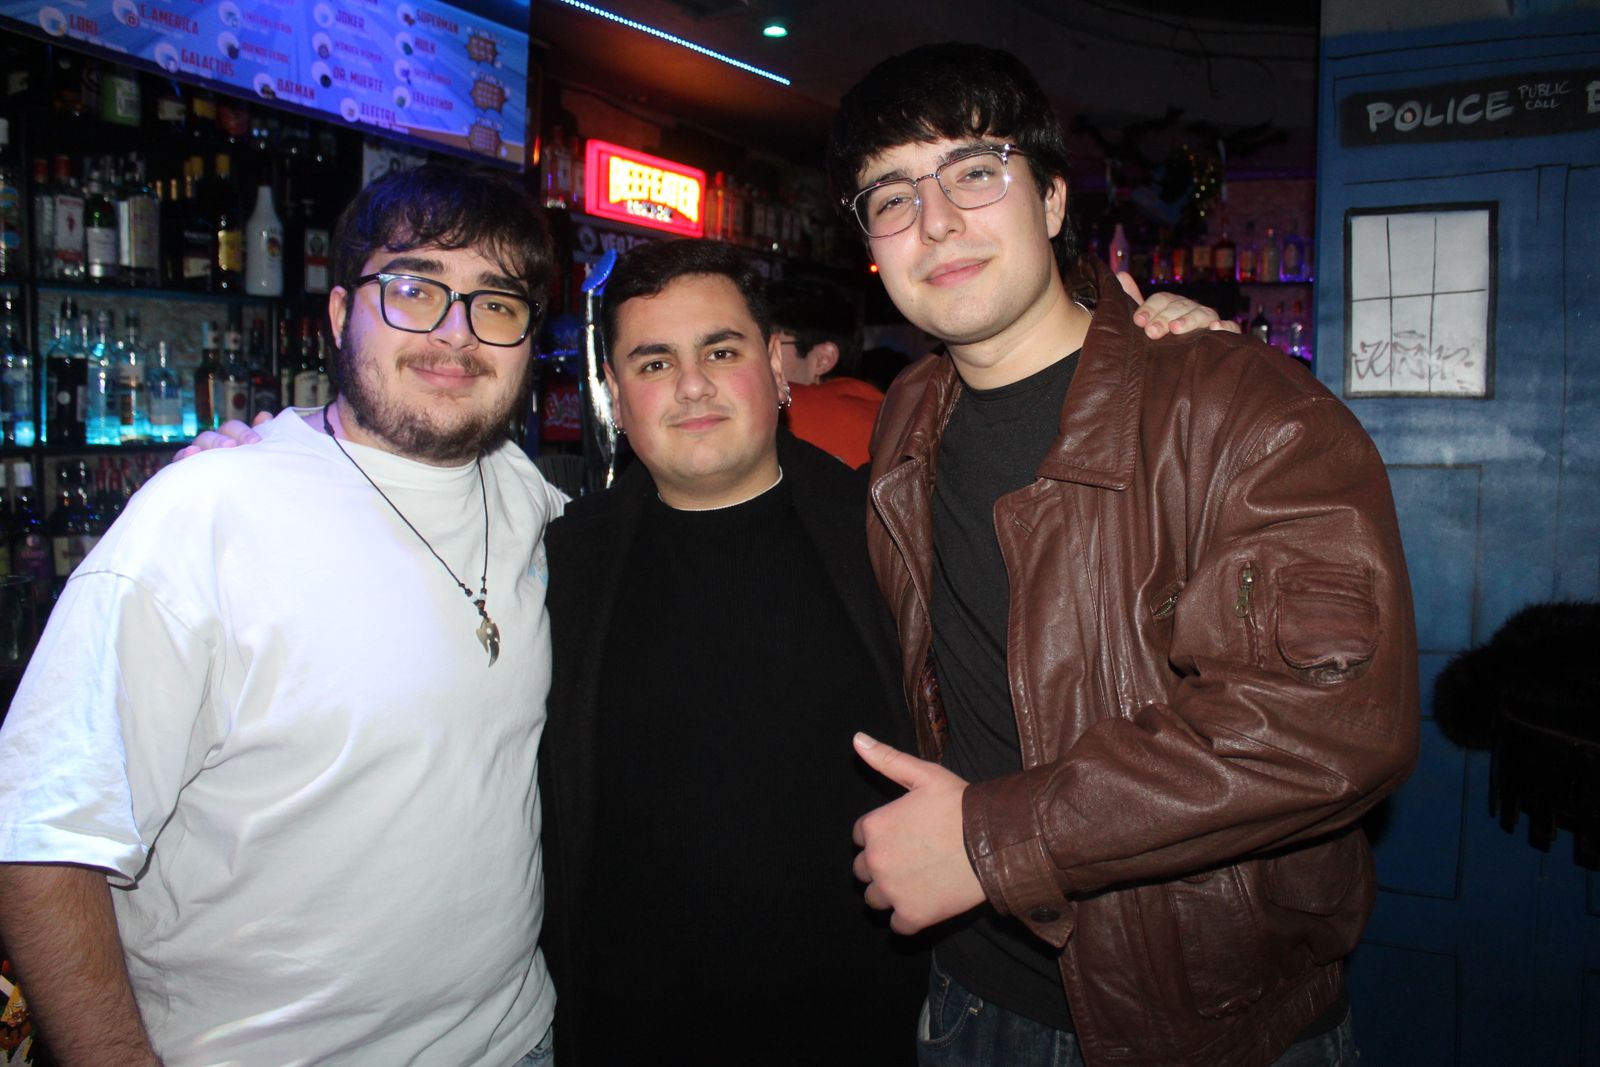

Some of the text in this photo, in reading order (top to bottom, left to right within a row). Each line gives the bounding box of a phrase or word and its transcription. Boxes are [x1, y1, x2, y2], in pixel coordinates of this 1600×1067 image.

[335, 10, 365, 30] JOKER
[416, 10, 459, 33] SUPERMAN
[181, 48, 235, 77] GALACTUS
[277, 78, 315, 100] BATMAN
[1518, 80, 1572, 99] PUBLIC
[1366, 91, 1516, 133] POLICE
[1525, 96, 1560, 110] CALL
